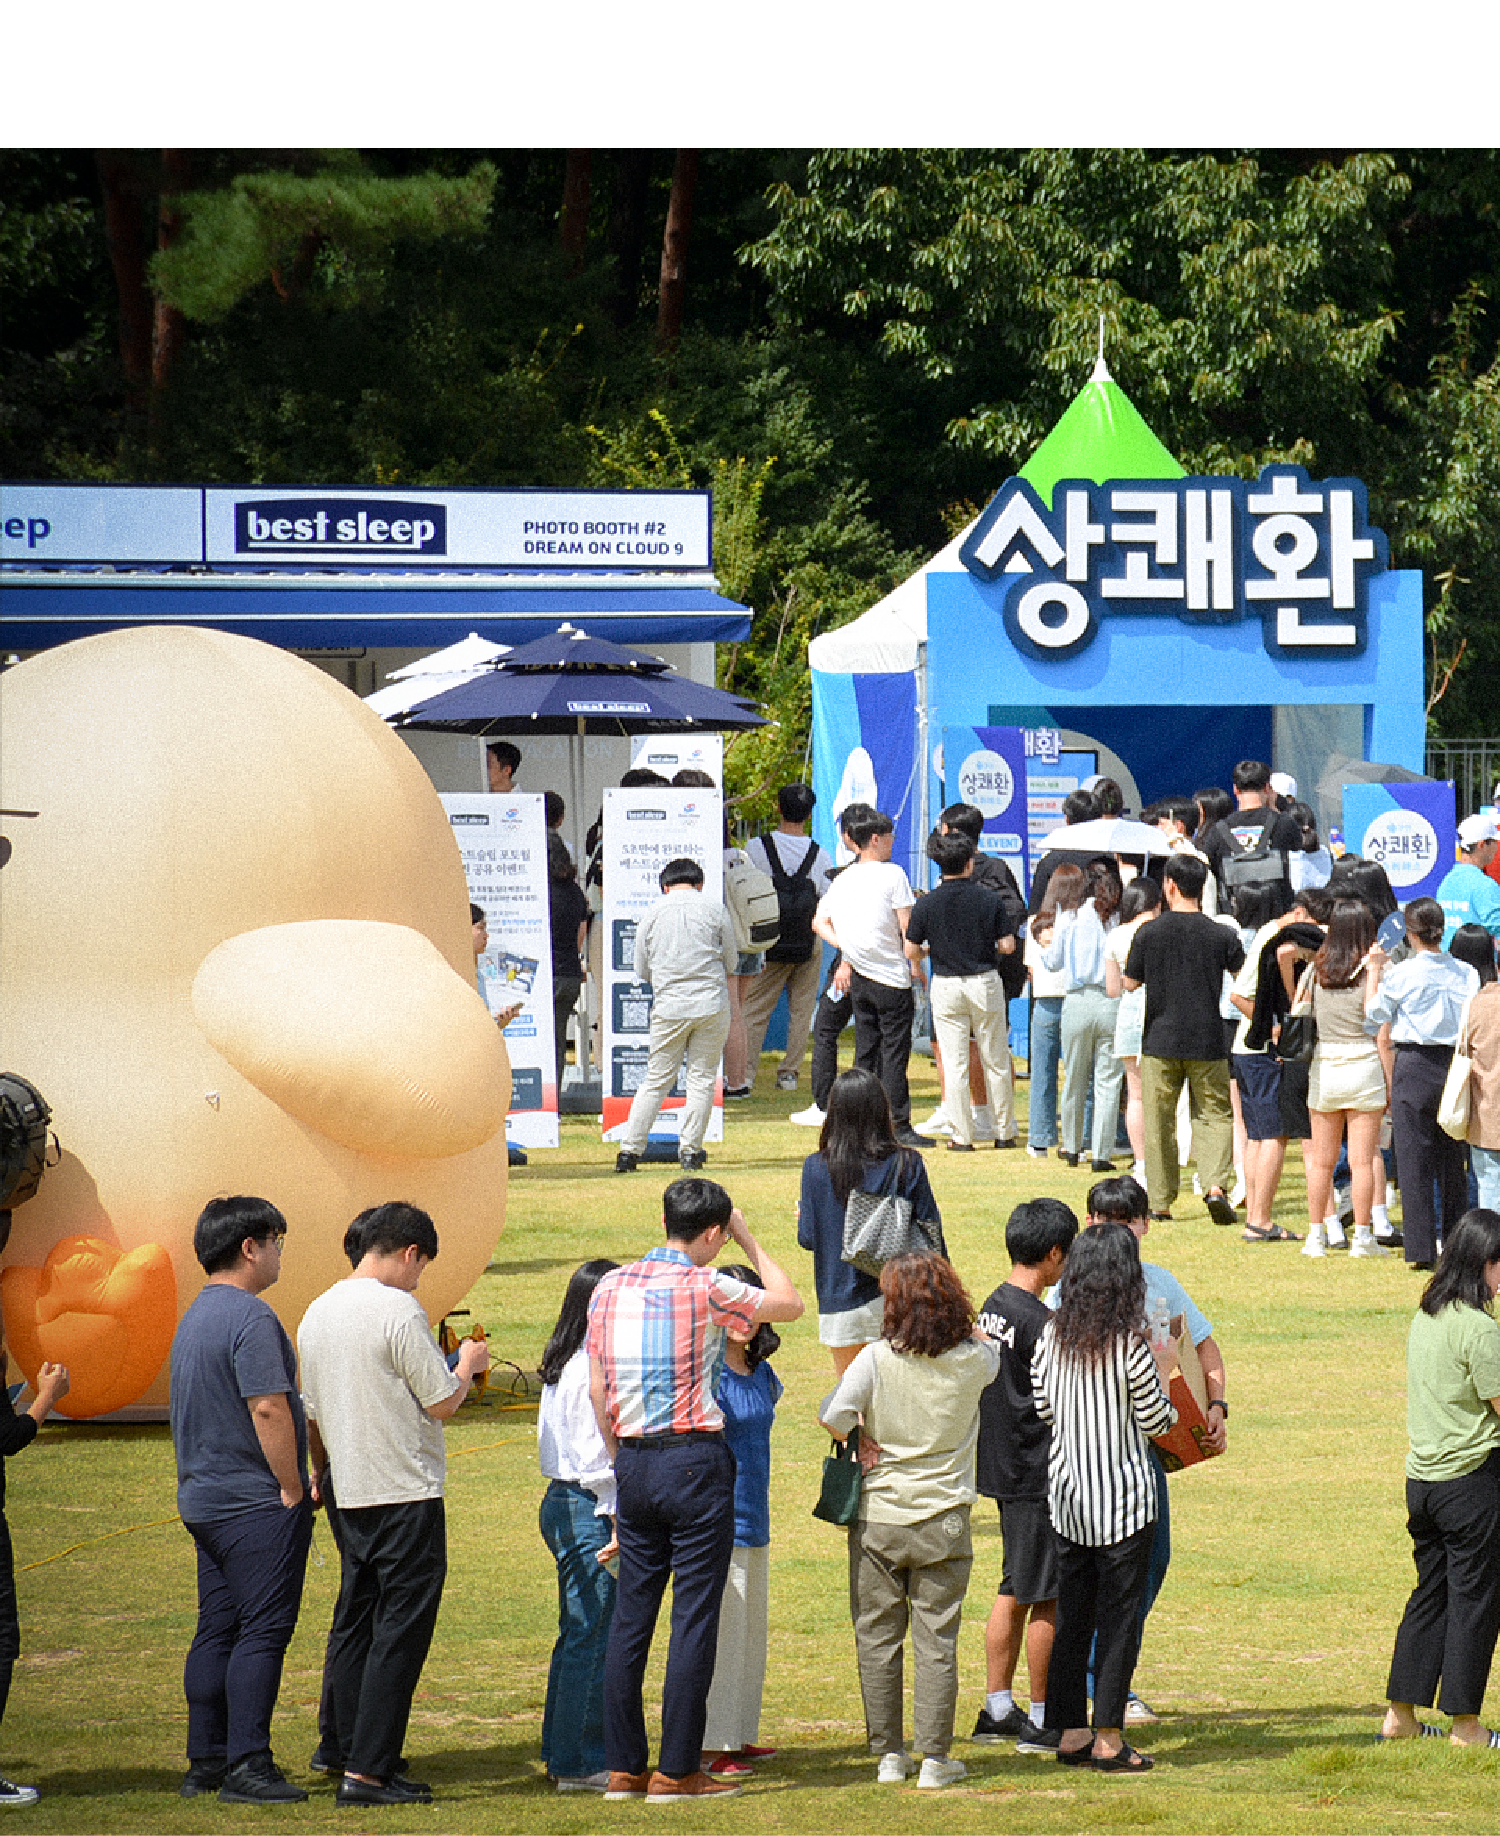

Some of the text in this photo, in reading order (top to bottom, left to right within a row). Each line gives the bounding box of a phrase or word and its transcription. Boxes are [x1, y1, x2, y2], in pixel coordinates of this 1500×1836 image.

[246, 511, 435, 547] best sleep
[524, 522, 666, 535] PHOTO BOOTH #2
[524, 541, 684, 556] DREAM ON CLOUD 9
[974, 475, 1375, 648] 상쾌환
[961, 772, 1010, 796] 상쾌환
[1368, 833, 1433, 862] 상쾌환
